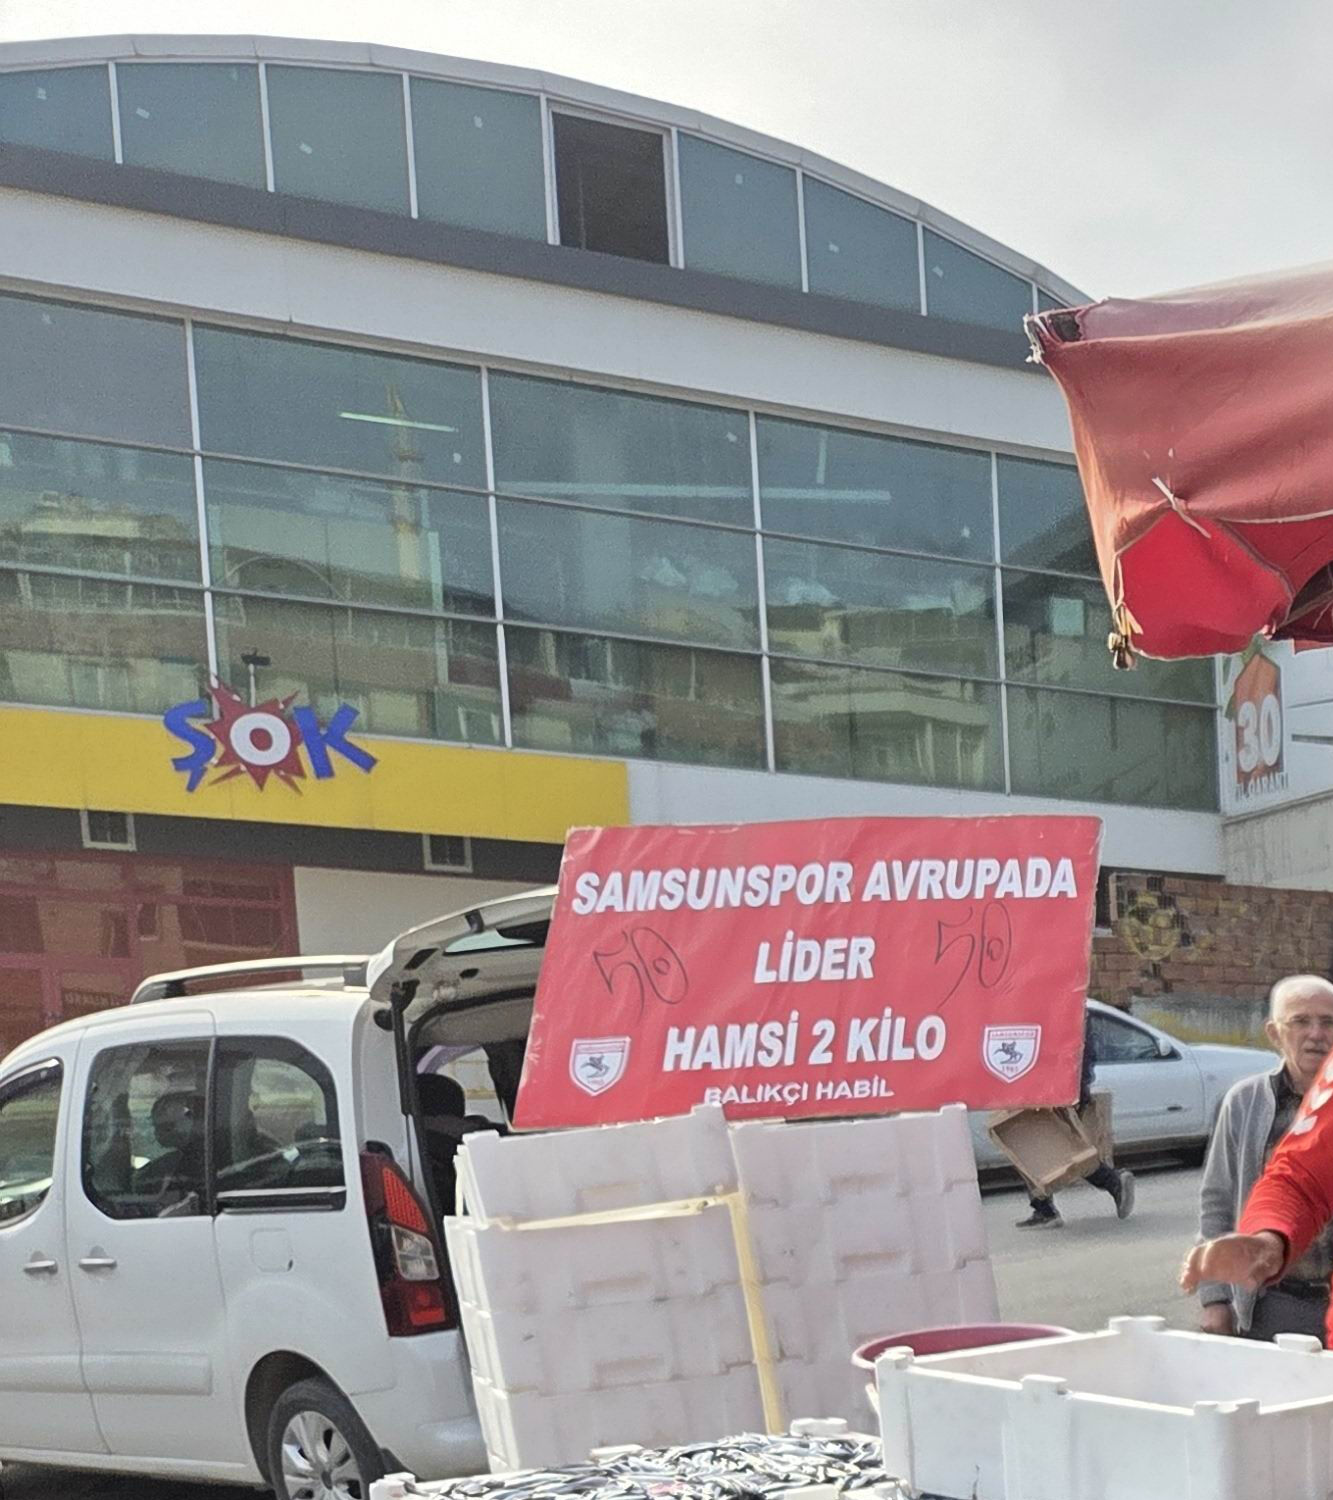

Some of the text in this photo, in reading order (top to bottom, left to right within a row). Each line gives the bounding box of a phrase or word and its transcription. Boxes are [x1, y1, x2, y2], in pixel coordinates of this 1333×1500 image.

[164, 697, 379, 793] ŞOK
[1236, 692, 1282, 774] 30
[571, 857, 1078, 916] SAMSUNSPOR AVRUPADA
[592, 926, 690, 1027] 50
[754, 929, 876, 984] LİDER
[934, 900, 1013, 1010] 50
[662, 1006, 946, 1072] HAMSİ 2 KİLO
[703, 1073, 896, 1106] BALIKÇI HABİL
